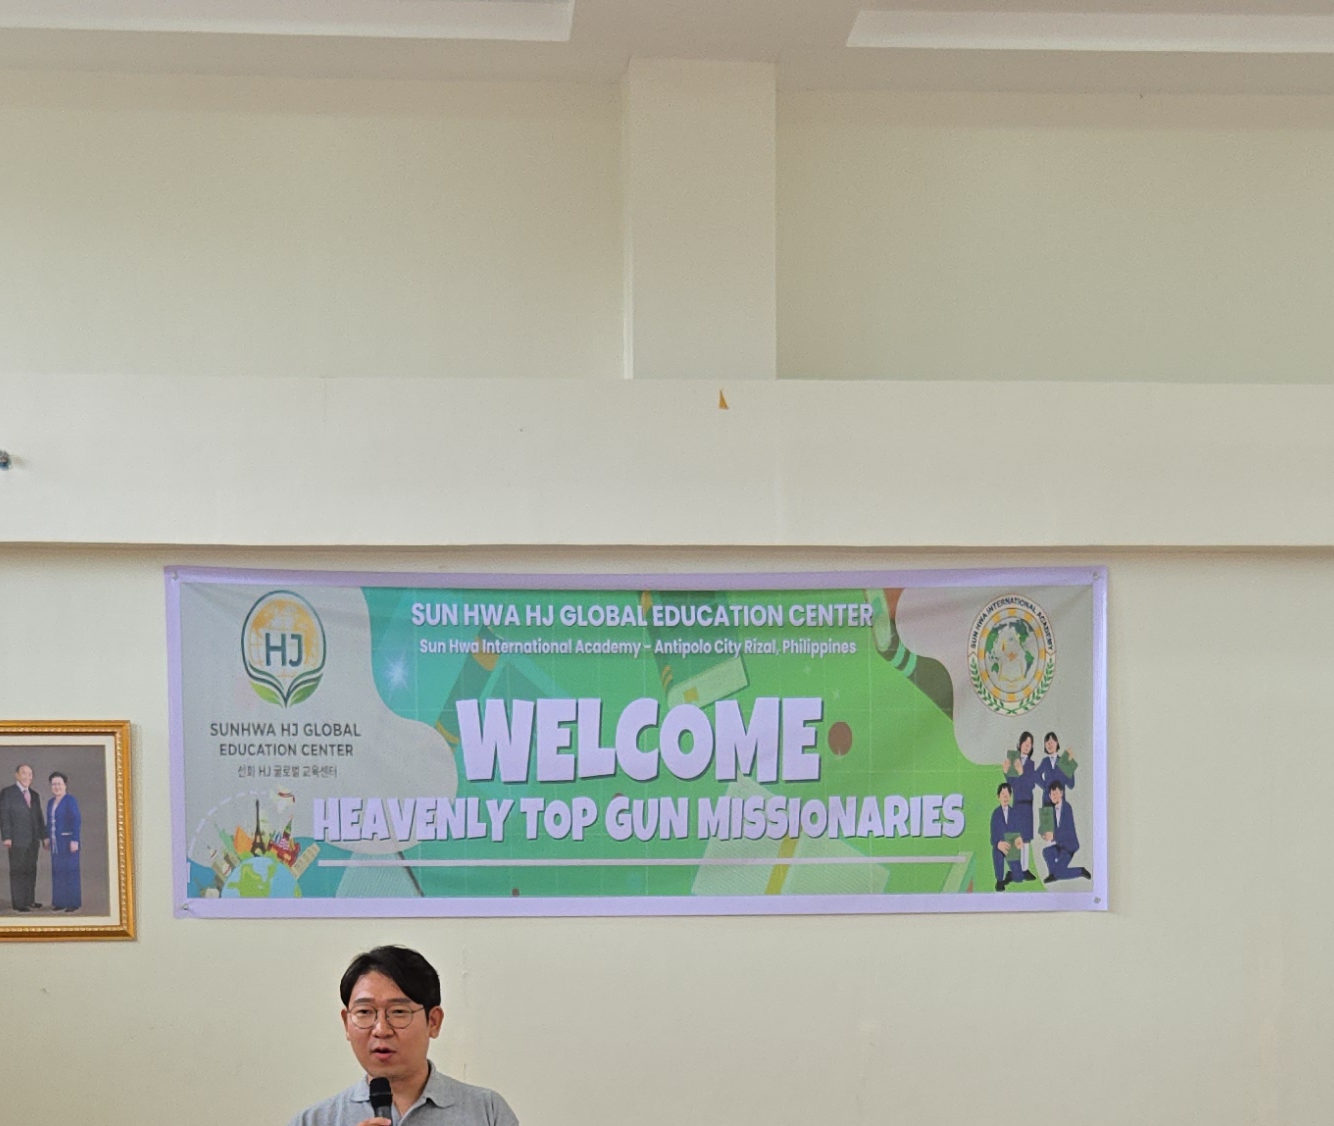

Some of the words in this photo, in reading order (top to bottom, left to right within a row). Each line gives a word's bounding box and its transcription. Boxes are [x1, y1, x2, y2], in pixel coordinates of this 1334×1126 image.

[411, 603, 459, 627] SUN
[464, 604, 521, 627] HWA
[526, 605, 554, 627] HJ
[560, 605, 648, 627] GLOBAL
[652, 604, 784, 627] EDUCATION
[789, 603, 874, 627] CENTER
[265, 632, 303, 667] HJ
[420, 638, 446, 654] Sun
[449, 638, 479, 654] Hwa
[482, 638, 572, 654] International
[575, 639, 641, 659] Academy
[654, 638, 711, 659] Antipolo
[714, 638, 742, 659] City
[745, 638, 778, 656] Rizal,
[782, 638, 857, 659] Philippines
[210, 722, 277, 737] SUNHWA
[281, 722, 299, 737] HJ
[303, 723, 361, 737] GLOBAL
[455, 697, 823, 784] WELCOME
[219, 743, 297, 756] EDUCATION
[301, 743, 354, 756] CENTER
[259, 765, 272, 777] HJ
[274, 765, 299, 778] 글로벌
[303, 765, 337, 778] 교육센터
[313, 796, 514, 842] HEAVENLY
[520, 796, 598, 841] TOP
[605, 795, 688, 842] GUN
[697, 793, 965, 841] MISSIONARIES
